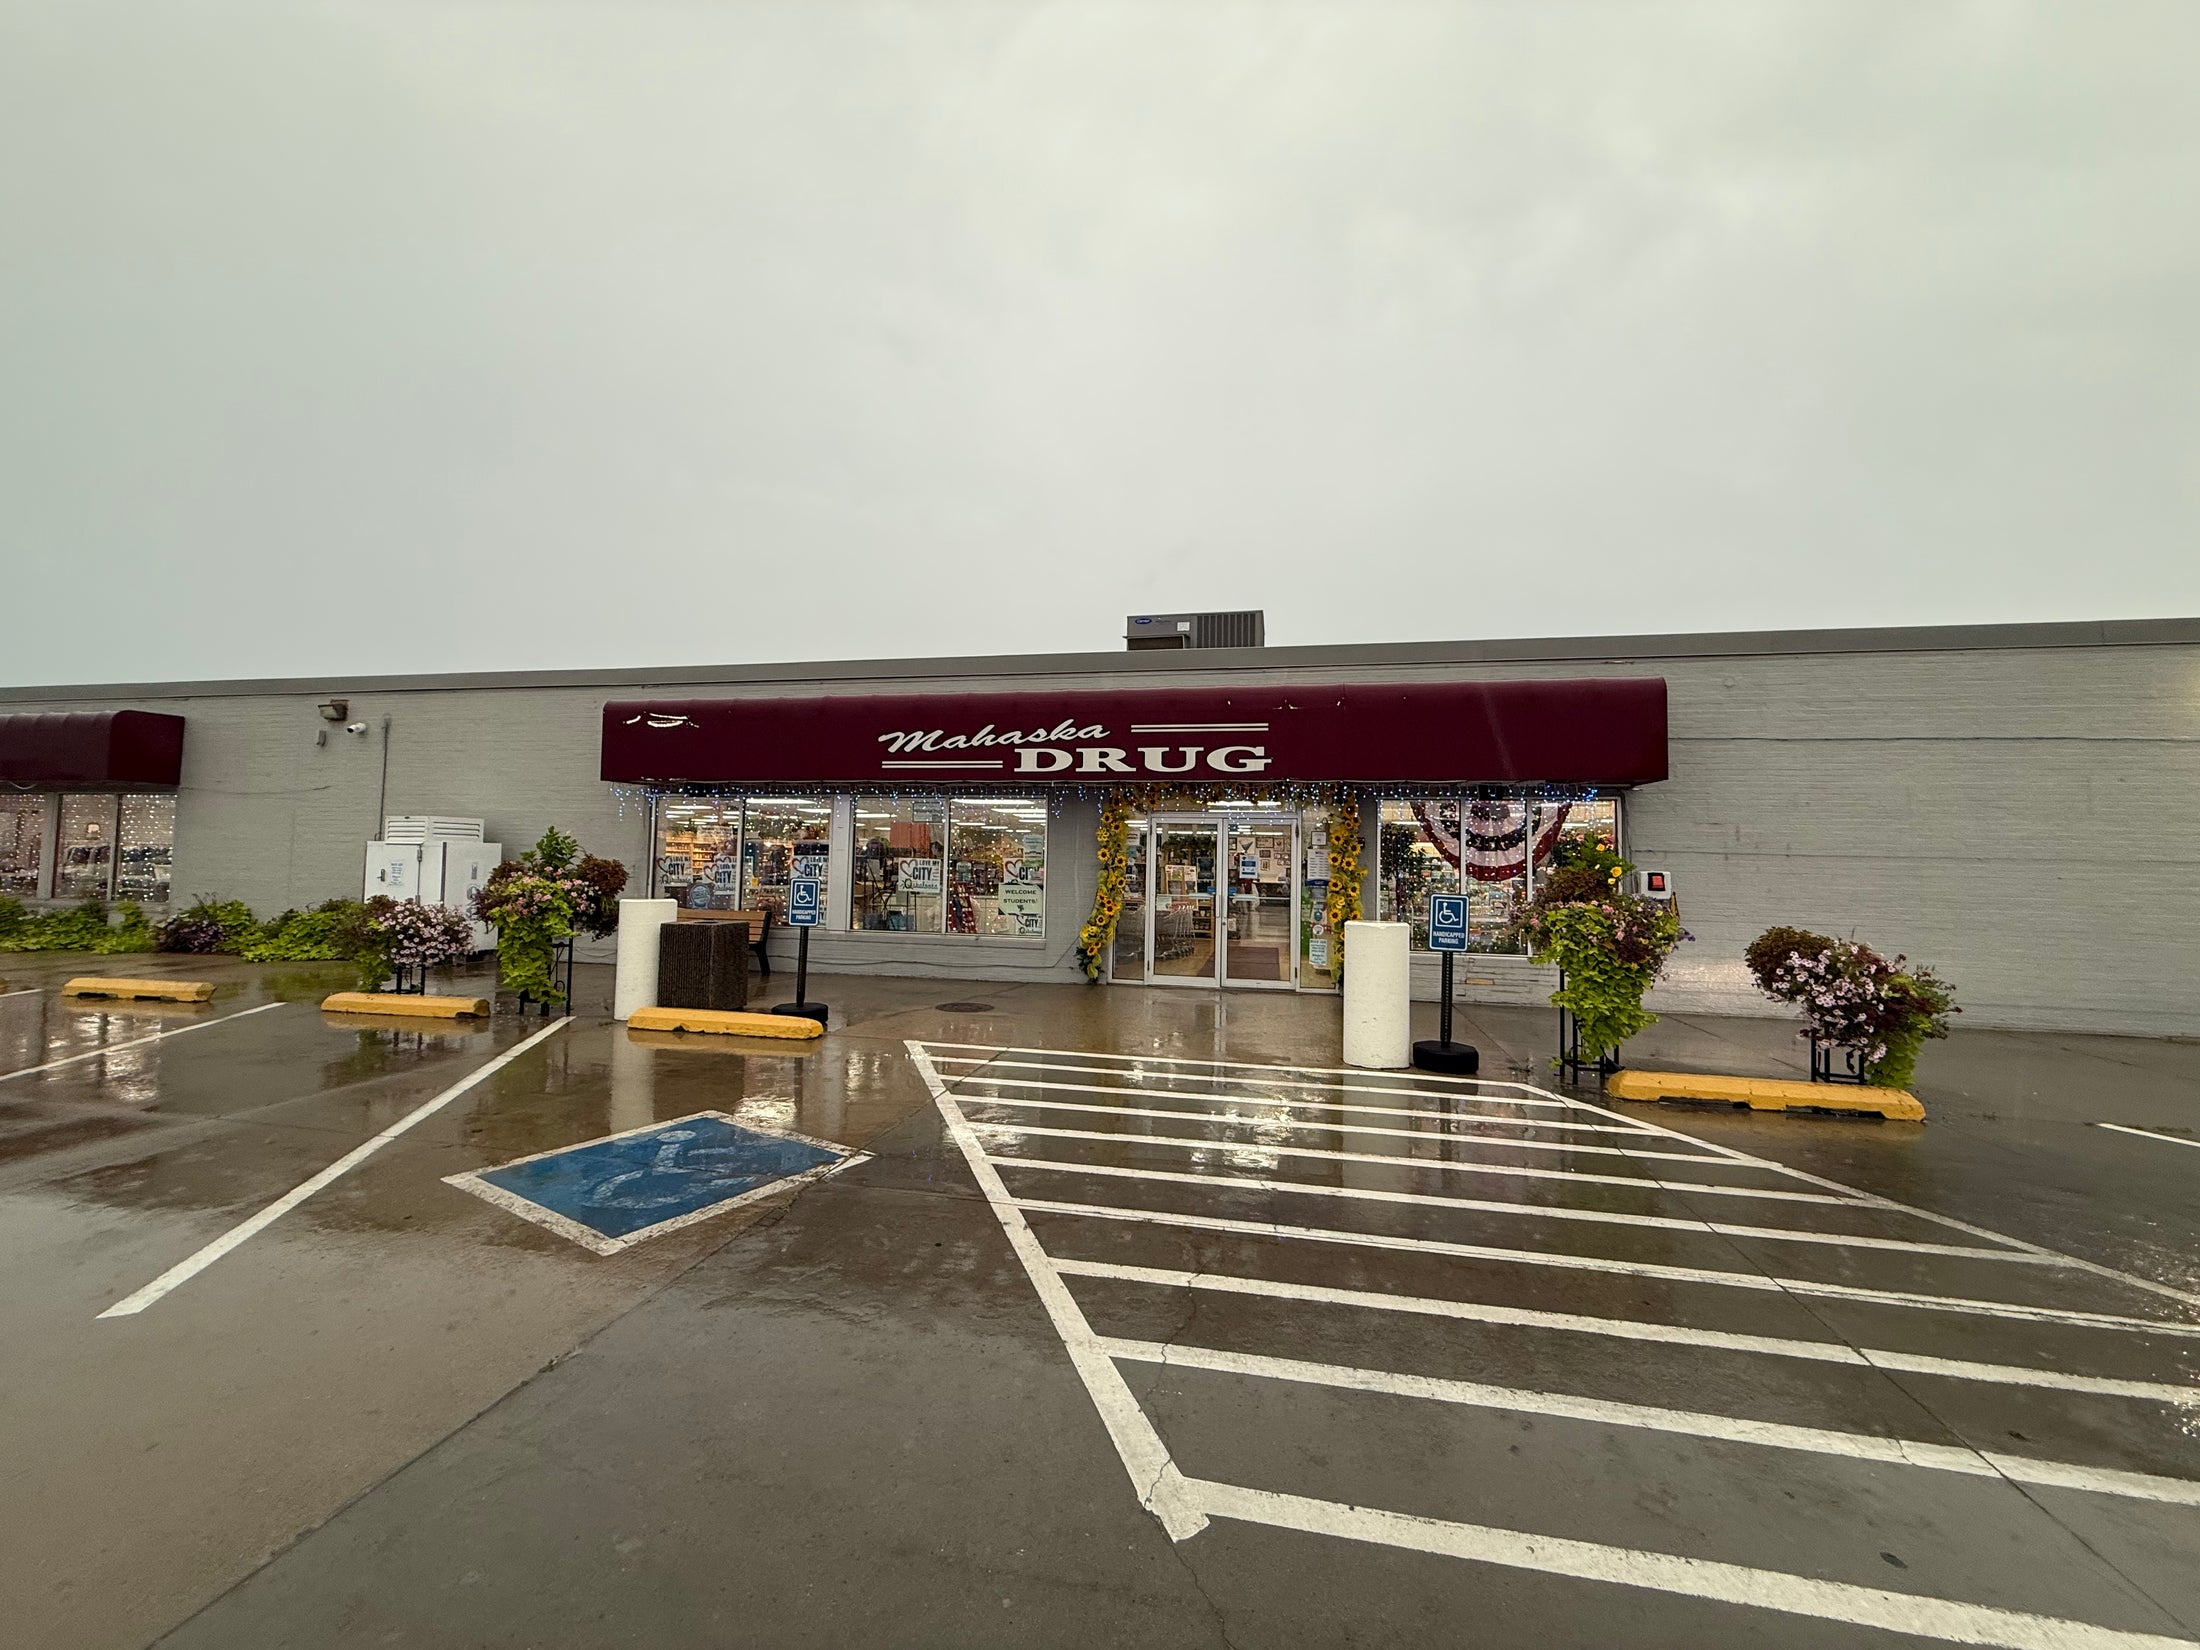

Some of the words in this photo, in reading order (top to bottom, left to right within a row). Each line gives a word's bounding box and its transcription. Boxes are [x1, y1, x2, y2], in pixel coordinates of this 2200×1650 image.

[878, 719, 1110, 753] Mahaska
[1013, 746, 1272, 772] DRUG
[668, 863, 685, 876] CITY
[804, 864, 823, 877] CITY
[913, 867, 932, 880] CITY
[715, 871, 732, 884] CITY
[1025, 918, 1039, 928] CITY
